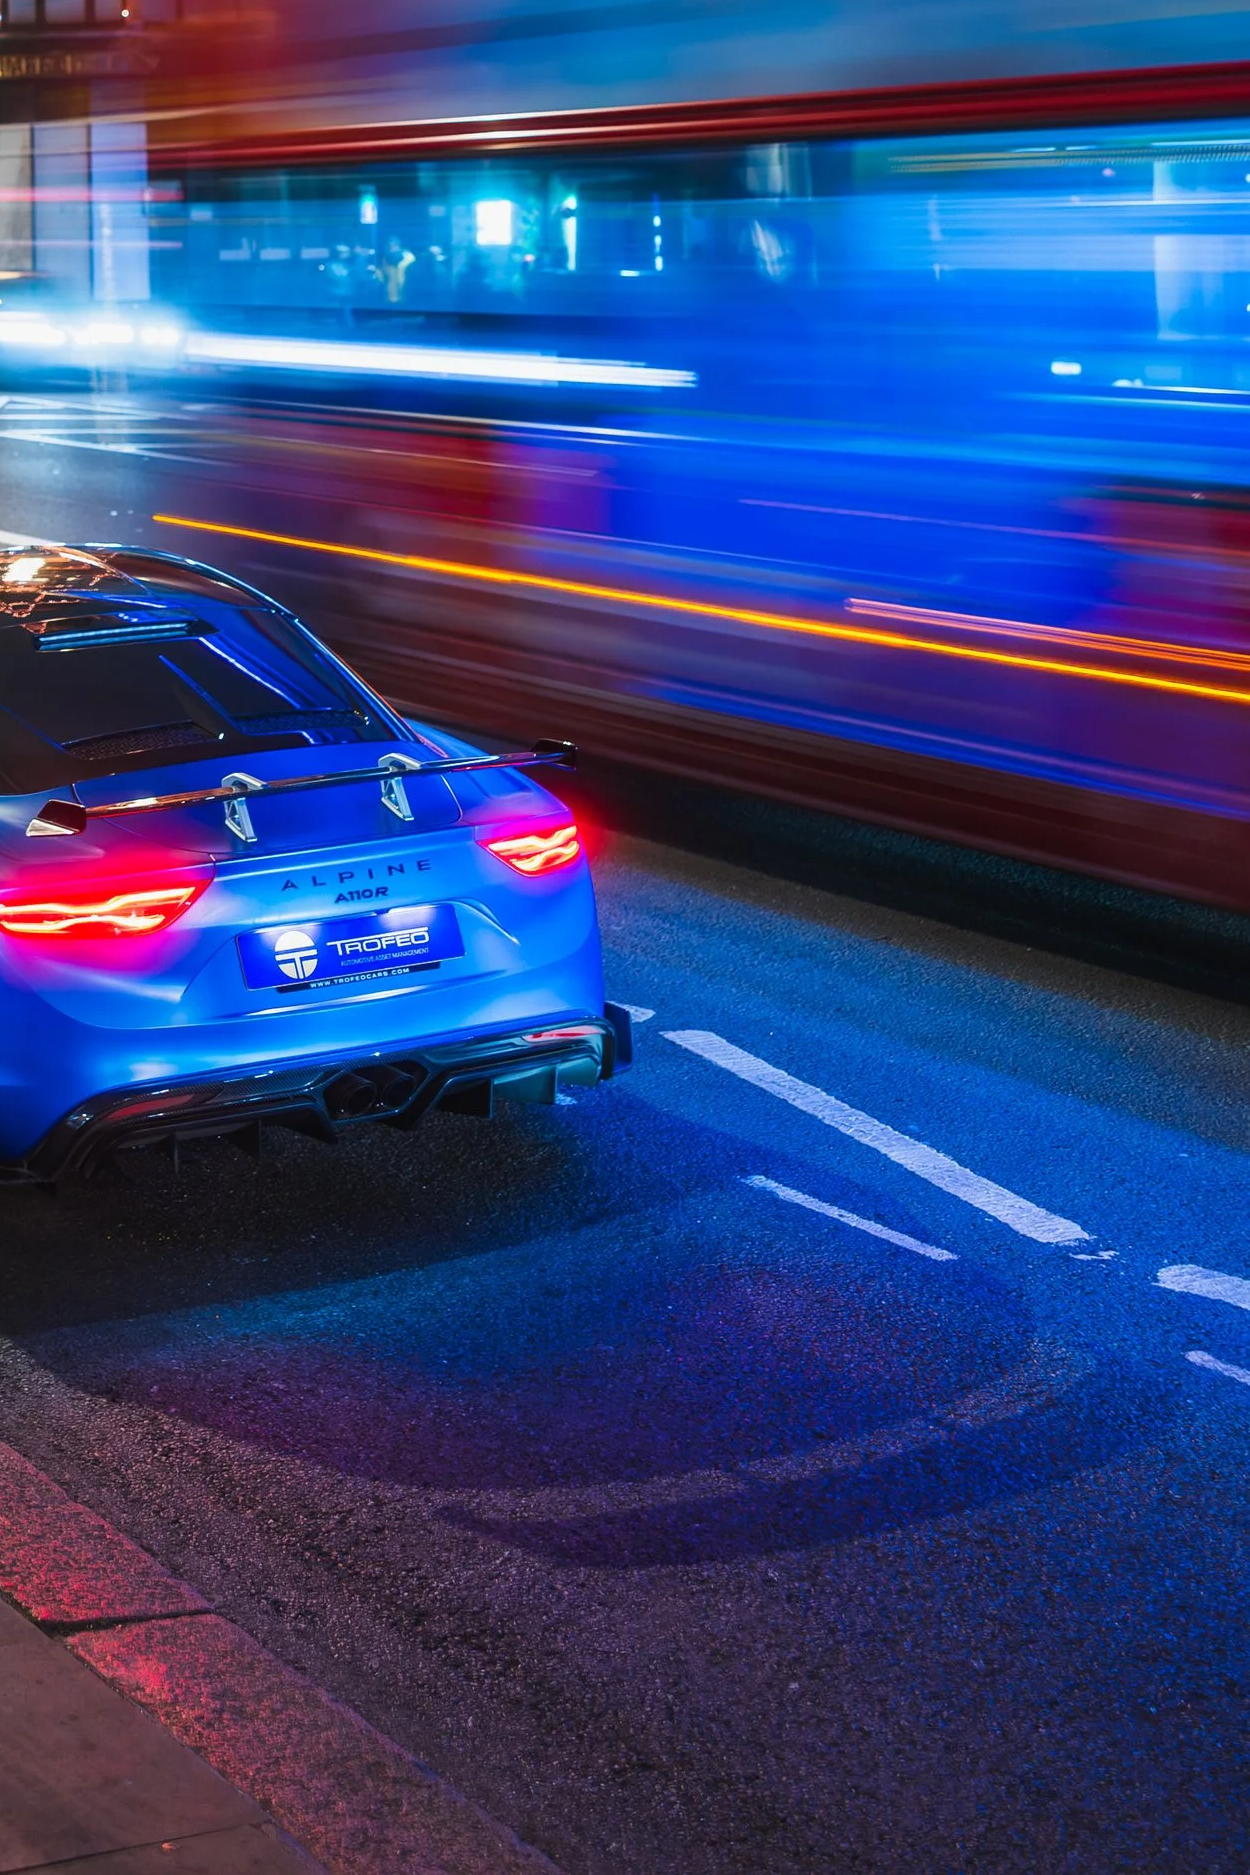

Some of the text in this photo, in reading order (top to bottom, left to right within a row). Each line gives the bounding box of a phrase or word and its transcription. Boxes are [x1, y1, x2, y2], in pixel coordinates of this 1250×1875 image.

[281, 859, 431, 892] ALPINE
[334, 886, 389, 904] A110R
[326, 926, 430, 956] TROFEO
[341, 947, 430, 966] AUTOMOTIVE ASSET MANAGEMENT
[310, 968, 410, 988] WWW.TROFEOCARS.COM
